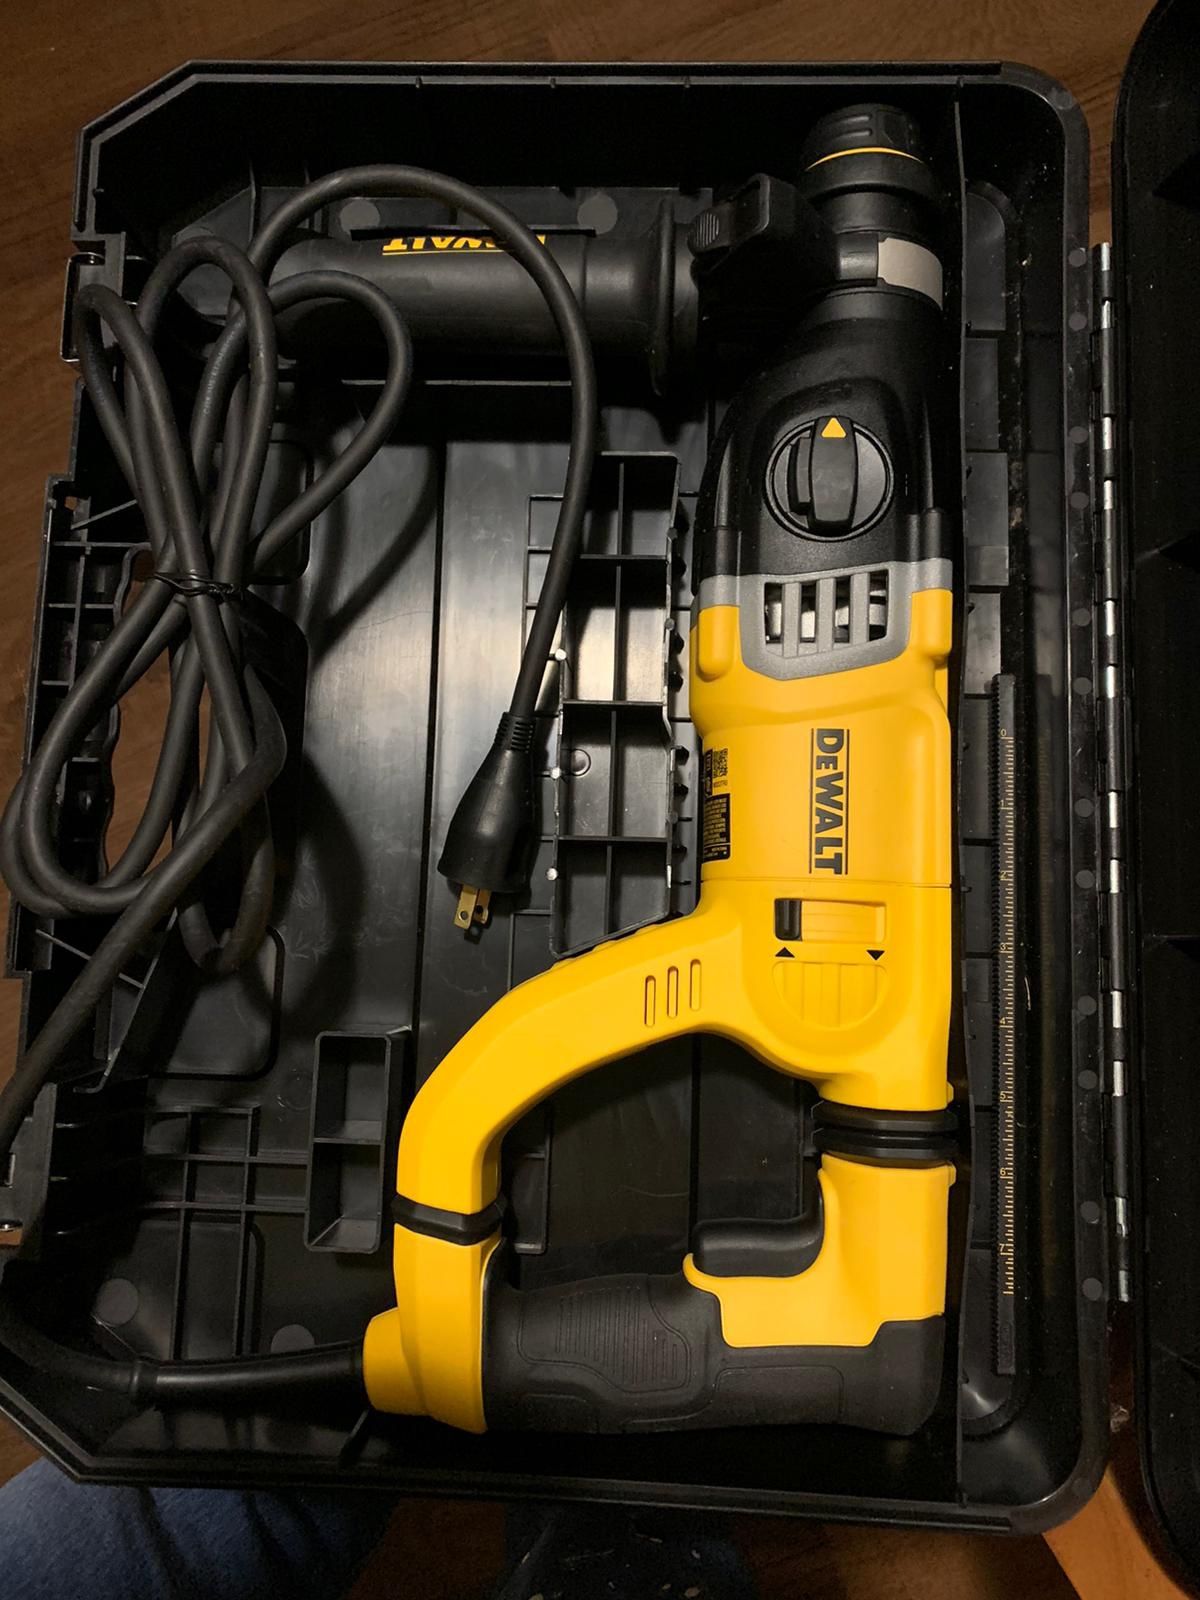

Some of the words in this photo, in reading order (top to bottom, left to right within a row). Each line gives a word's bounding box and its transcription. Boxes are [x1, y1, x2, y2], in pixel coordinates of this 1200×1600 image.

[1000, 728, 1007, 737] 0
[1000, 871, 1007, 879] 2
[1000, 942, 1007, 951] 3
[999, 1017, 1006, 1025] 4
[1000, 1091, 1006, 1100] 5
[1000, 1167, 1006, 1176] 6
[999, 1243, 1005, 1251] 7
